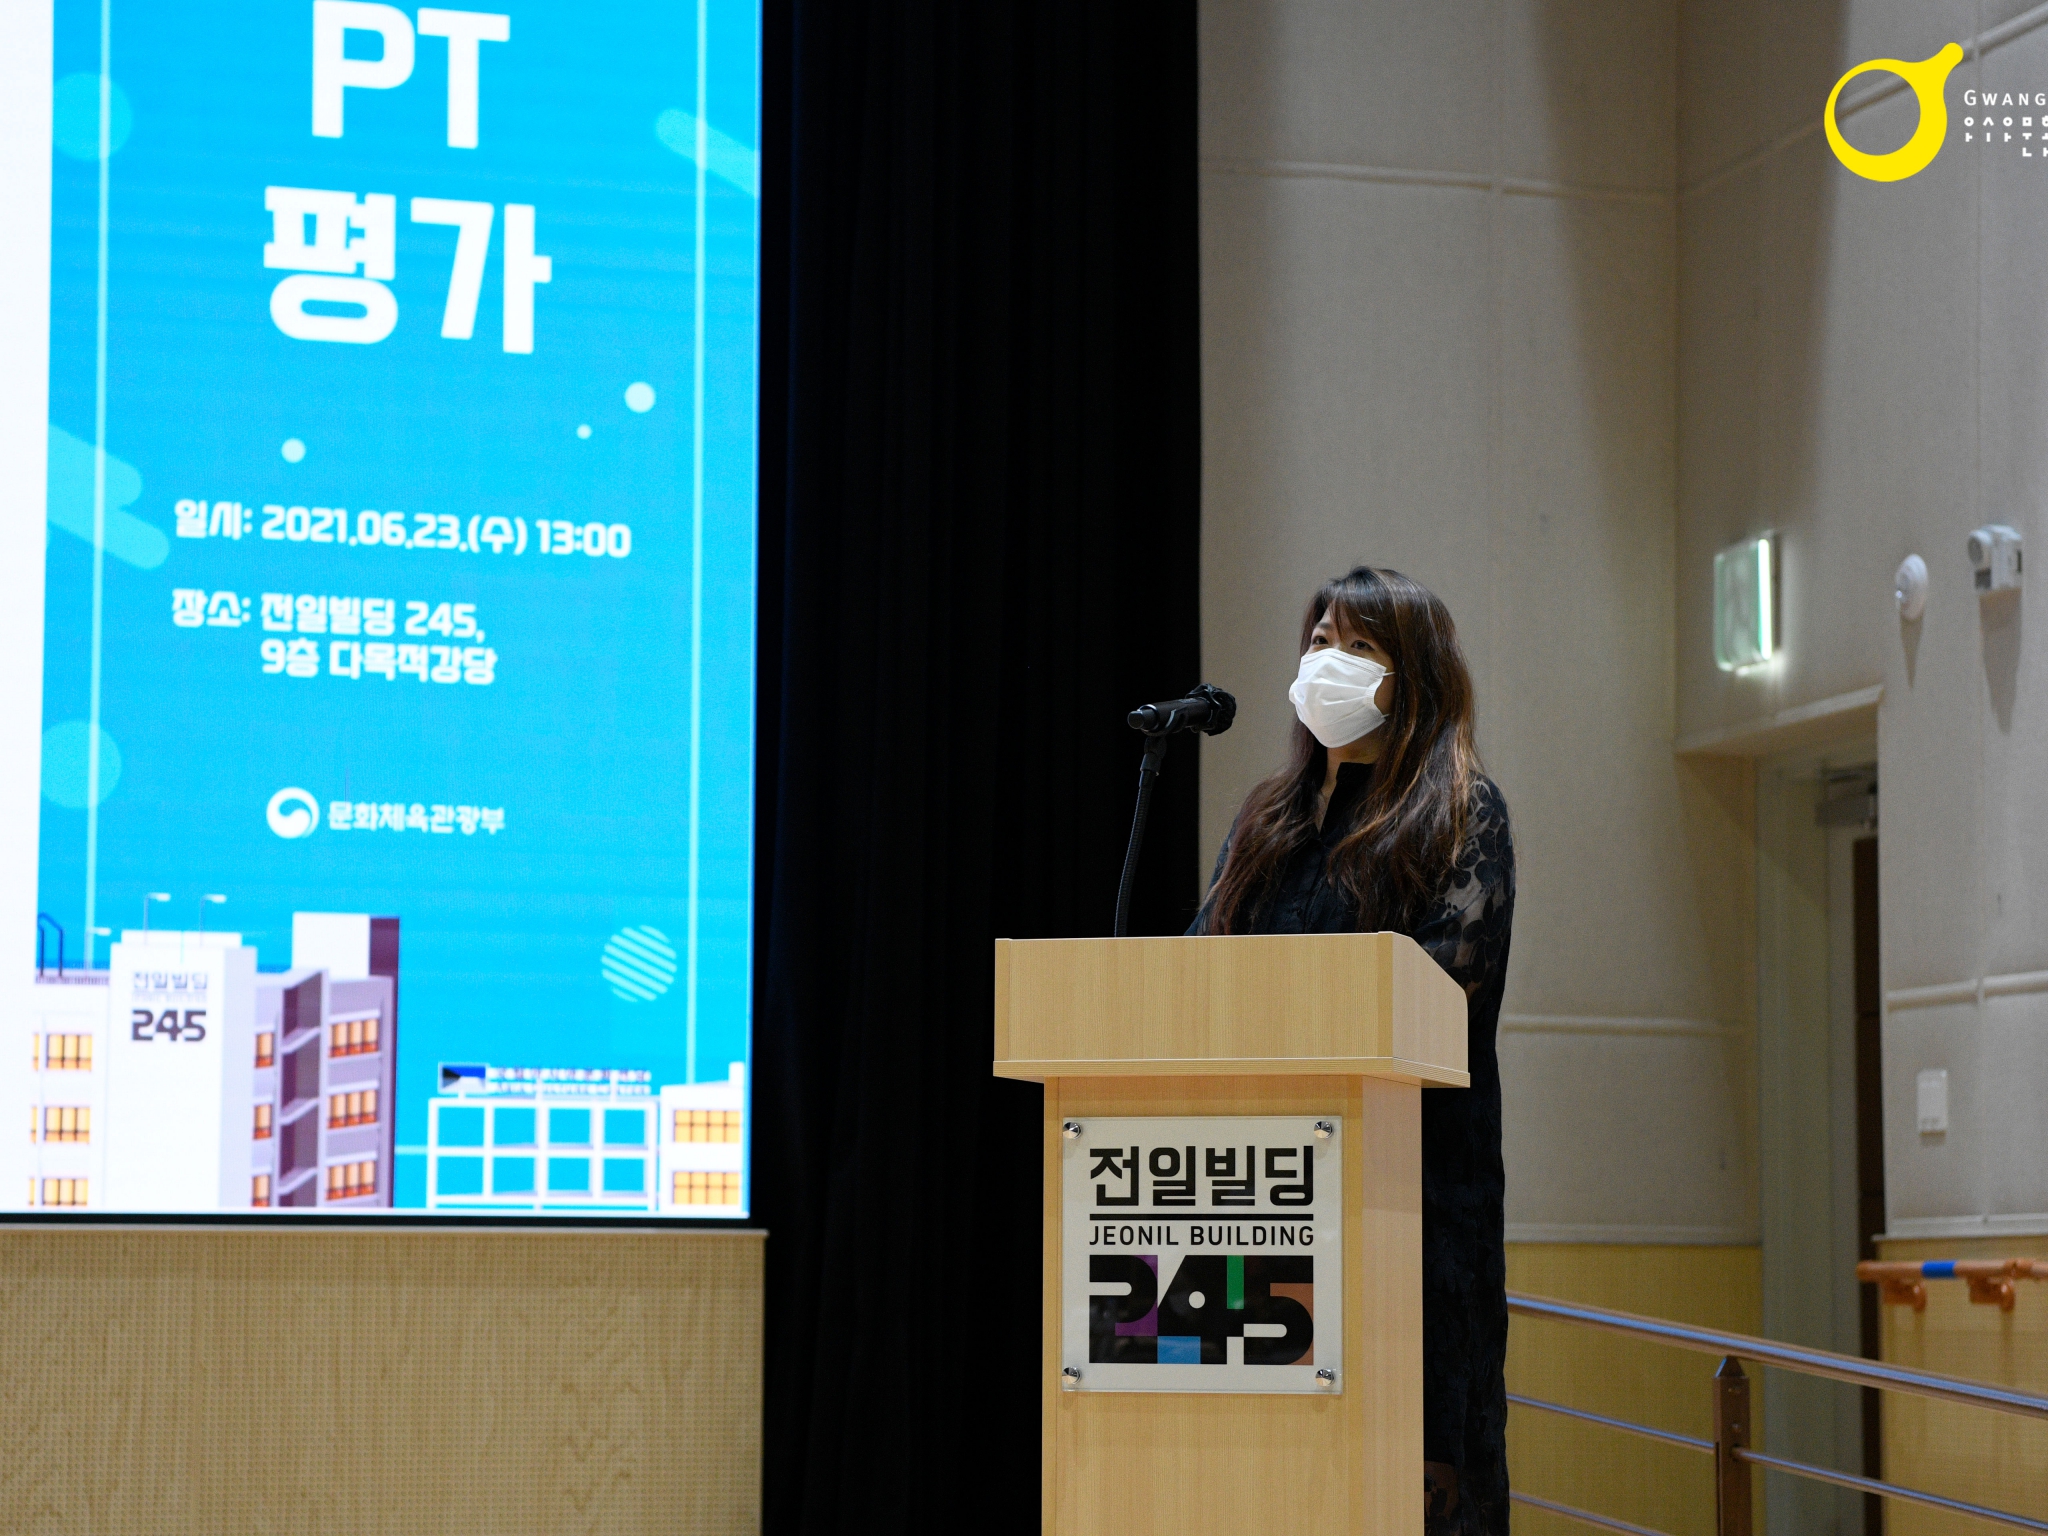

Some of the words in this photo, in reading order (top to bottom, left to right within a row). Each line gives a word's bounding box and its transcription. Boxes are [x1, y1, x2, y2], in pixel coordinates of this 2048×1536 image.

[312, 0, 510, 149] PT
[263, 186, 552, 354] 평가
[175, 499, 253, 540] 일시:
[535, 519, 632, 559] 13:00
[172, 588, 251, 628] 장소:
[261, 592, 395, 637] 전일빌딩
[404, 601, 485, 644] 245,
[261, 638, 320, 678] 9층
[329, 641, 498, 685] 다목적강당
[328, 800, 505, 836] 문화체육관광부
[132, 1009, 207, 1042] 245
[1089, 1146, 1314, 1206] 전일빌딩
[1089, 1225, 1179, 1246] JEONIL
[1190, 1225, 1314, 1246] BUILDING
[1089, 1255, 1314, 1366] 245
